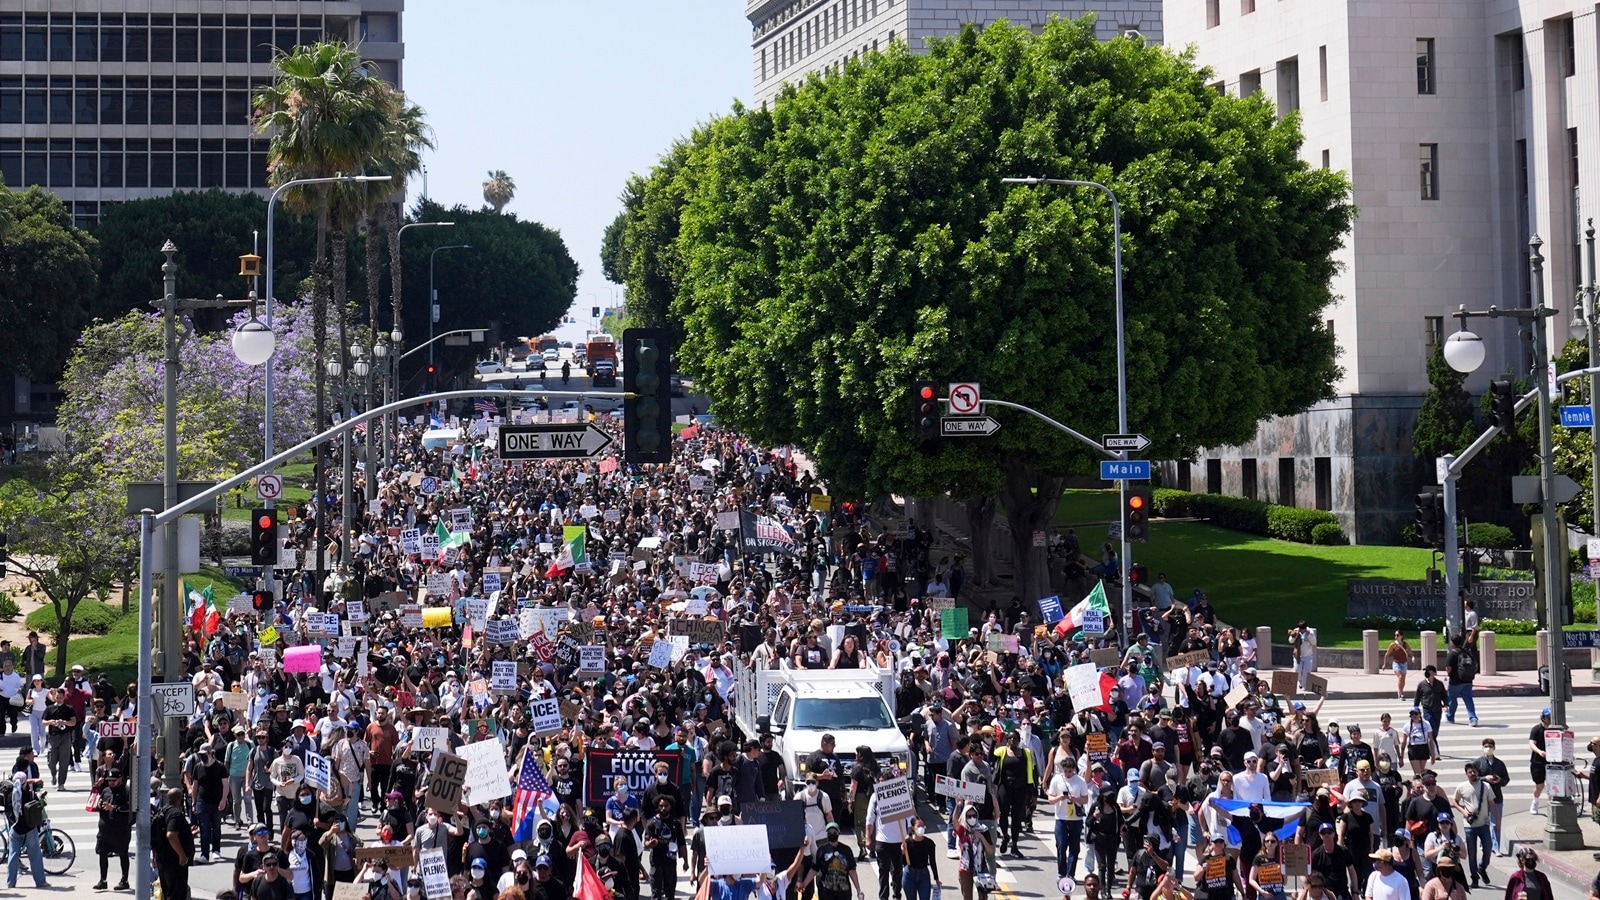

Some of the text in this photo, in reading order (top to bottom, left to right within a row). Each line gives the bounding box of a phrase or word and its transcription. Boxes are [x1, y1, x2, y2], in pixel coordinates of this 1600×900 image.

[1564, 411, 1590, 423] Temple
[946, 422, 986, 430] ONE WAY
[508, 434, 584, 450] ONE WAY
[1110, 464, 1141, 474] Main
[402, 530, 418, 538] ICE
[746, 538, 802, 556] ON STOLEN LAN
[698, 564, 718, 574] FUCK
[696, 572, 716, 585] ICE
[1353, 586, 1534, 596] UNITED STATES OURT HOU
[1486, 600, 1522, 608] STREET
[324, 616, 337, 624] CE:
[530, 634, 549, 648] FUCK
[1566, 632, 1600, 640] North Ma
[654, 641, 670, 650] GET
[536, 643, 557, 661] ICE
[1312, 683, 1322, 696] ICE
[475, 699, 490, 709] LA
[532, 702, 557, 718] ICE:
[100, 723, 138, 736] ICE OU
[419, 728, 440, 737] ABOLISH
[307, 754, 328, 774] ICE:
[438, 756, 467, 781] ICE
[611, 759, 657, 774] FUCK
[602, 775, 656, 790] TUM
[1308, 773, 1320, 785] NO
[432, 779, 462, 802] OUT
[878, 787, 907, 801] PLENOS
[424, 864, 446, 876] PLENOS
